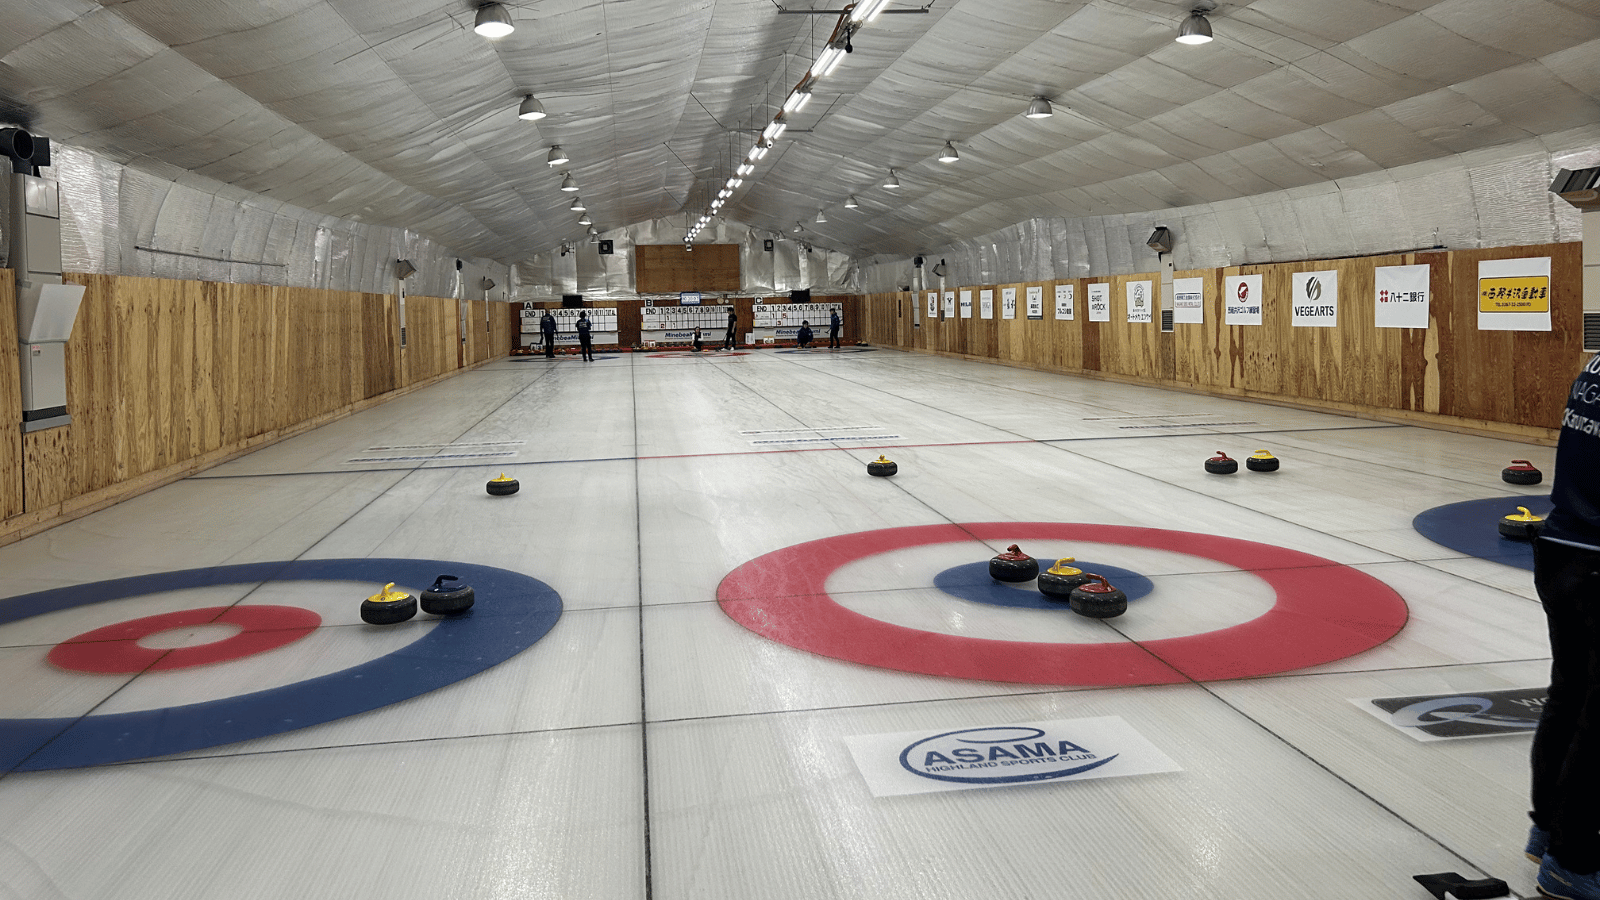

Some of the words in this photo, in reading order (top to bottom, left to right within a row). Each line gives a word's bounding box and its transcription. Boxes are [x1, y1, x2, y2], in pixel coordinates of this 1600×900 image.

[1390, 291, 1424, 302] 八十二銀行
[1295, 306, 1334, 316] VEGEARTS
[924, 740, 1091, 766] ASAMA
[925, 762, 998, 773] HIGHLAND
[1000, 757, 1057, 767] SPORTS
[1060, 753, 1097, 762] CLUB
